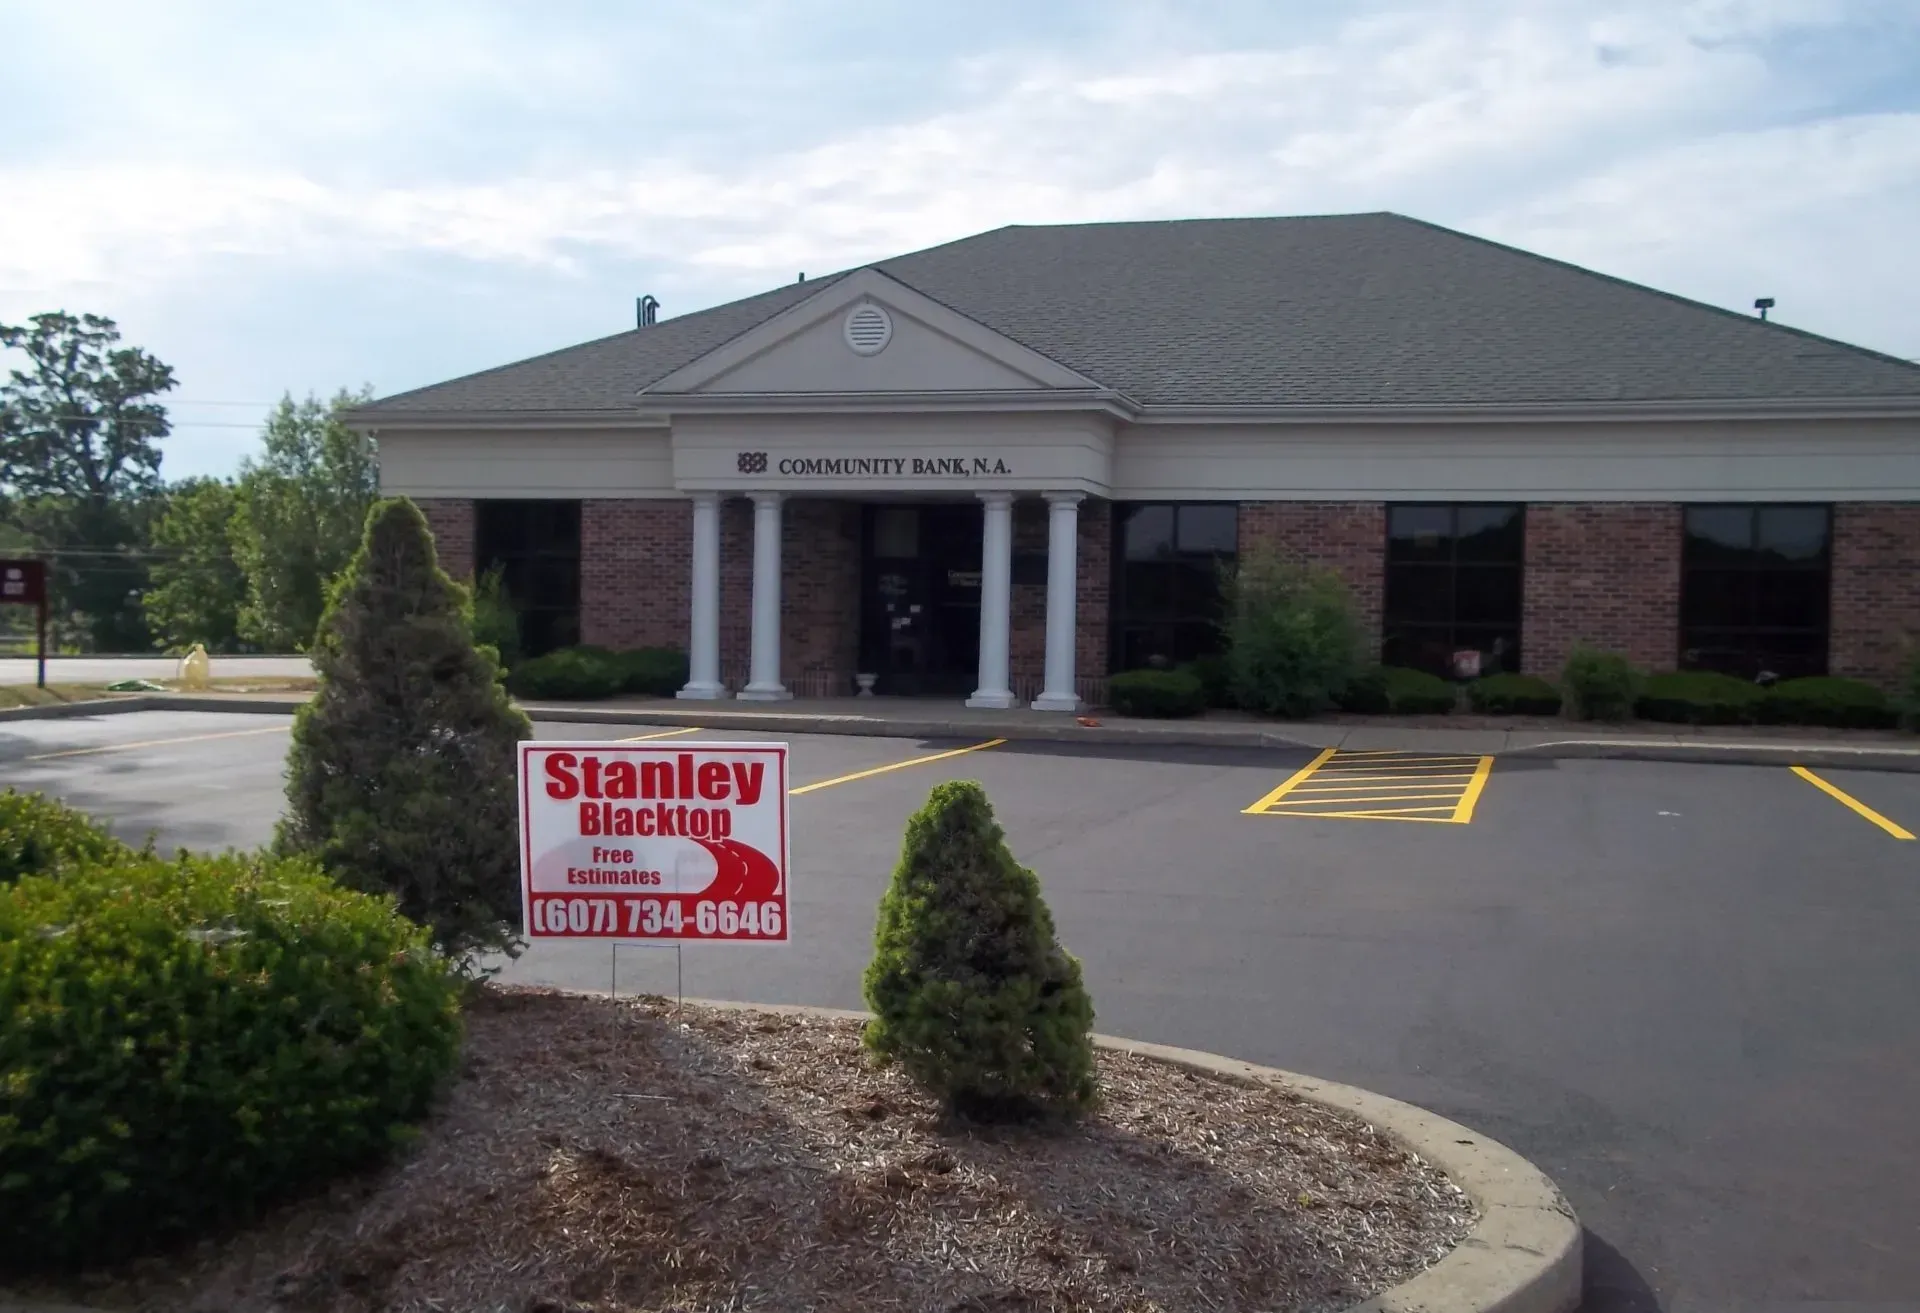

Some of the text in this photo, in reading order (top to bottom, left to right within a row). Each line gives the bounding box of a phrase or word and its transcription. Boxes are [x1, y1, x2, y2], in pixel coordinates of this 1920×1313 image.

[779, 458, 906, 475] COMMUNITY
[544, 752, 764, 806] Stanley
[580, 802, 731, 841] Blacktop
[592, 846, 634, 864] Free
[567, 867, 661, 885] Estimates
[532, 898, 782, 936] (607) 734-6646
